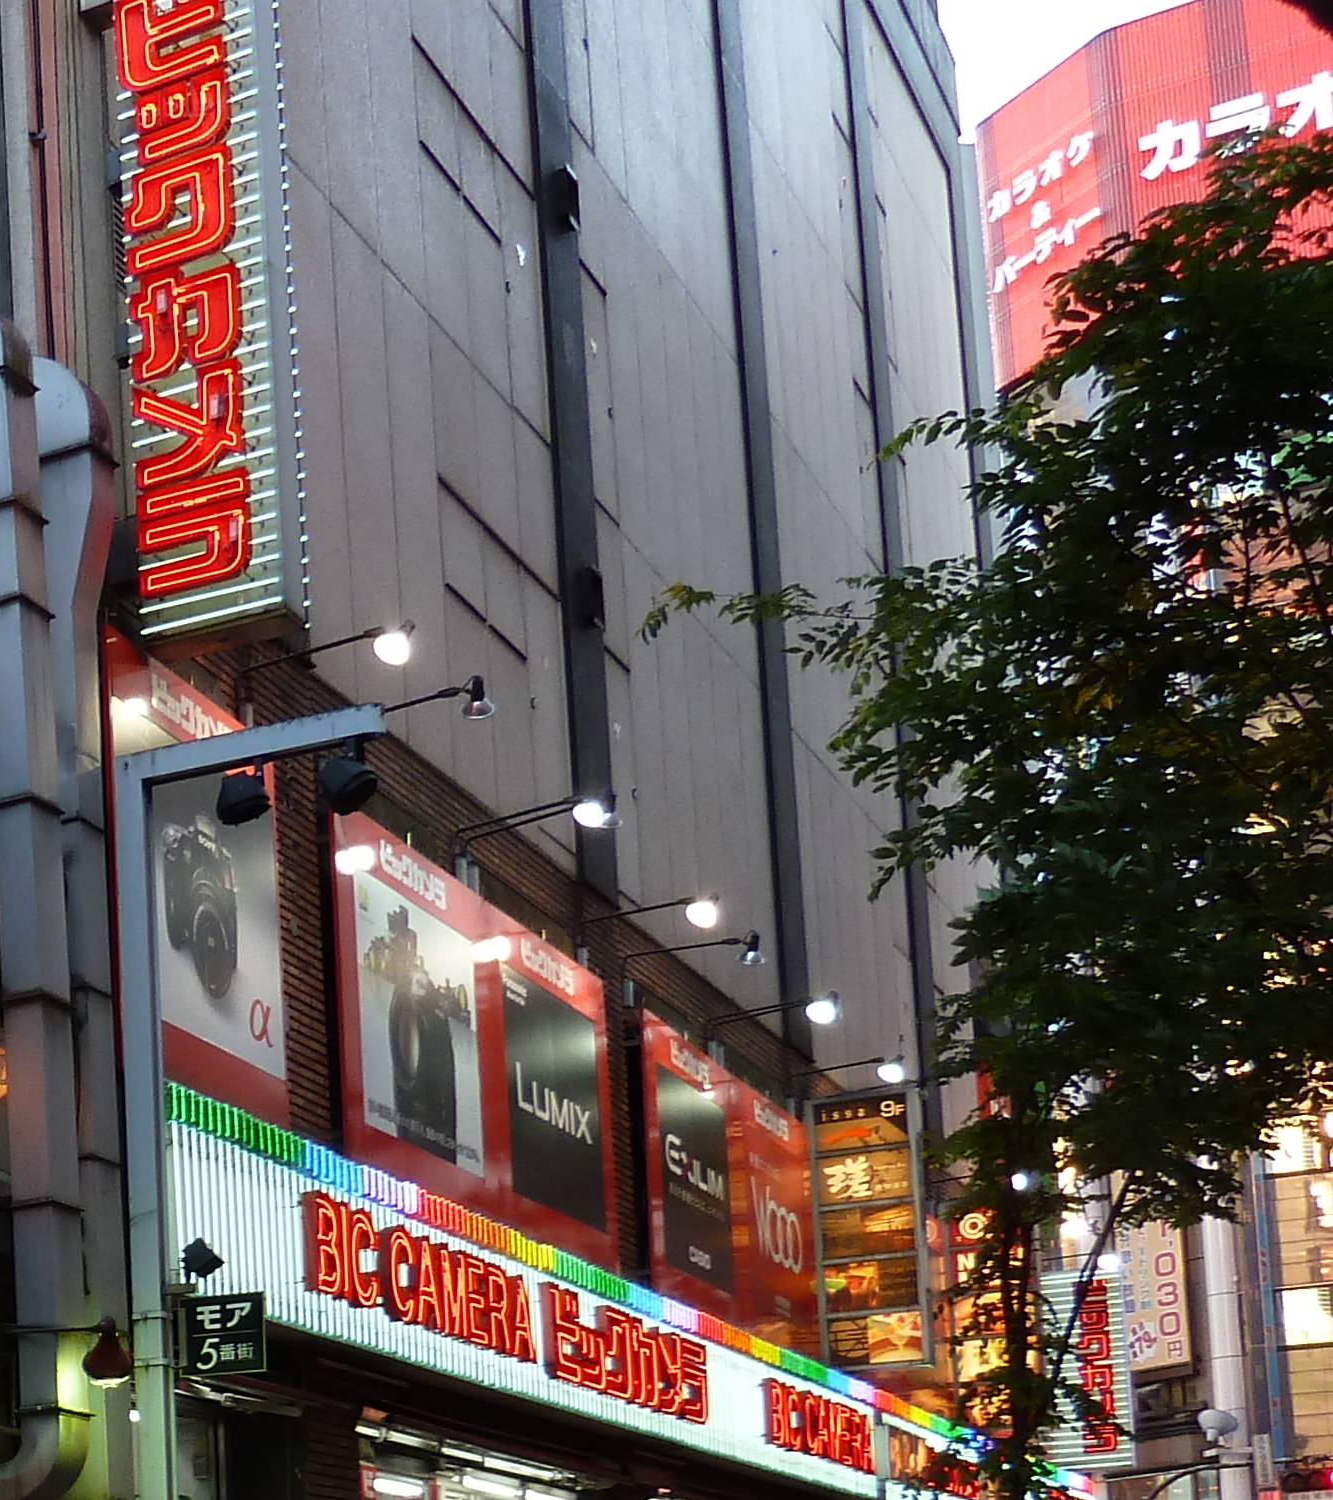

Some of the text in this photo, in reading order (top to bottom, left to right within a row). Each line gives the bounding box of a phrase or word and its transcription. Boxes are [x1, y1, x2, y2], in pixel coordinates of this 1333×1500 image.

[987, 131, 1093, 222] カラオケ
[379, 839, 447, 912] ビックカメラ
[515, 1061, 593, 1145] LUMIX
[196, 1302, 252, 1329] モア
[313, 1197, 535, 1363] BIC CAMERA
[196, 1338, 254, 1369] 5番街
[549, 1284, 709, 1424] ビックカメラ
[769, 1377, 802, 1450] BIC
